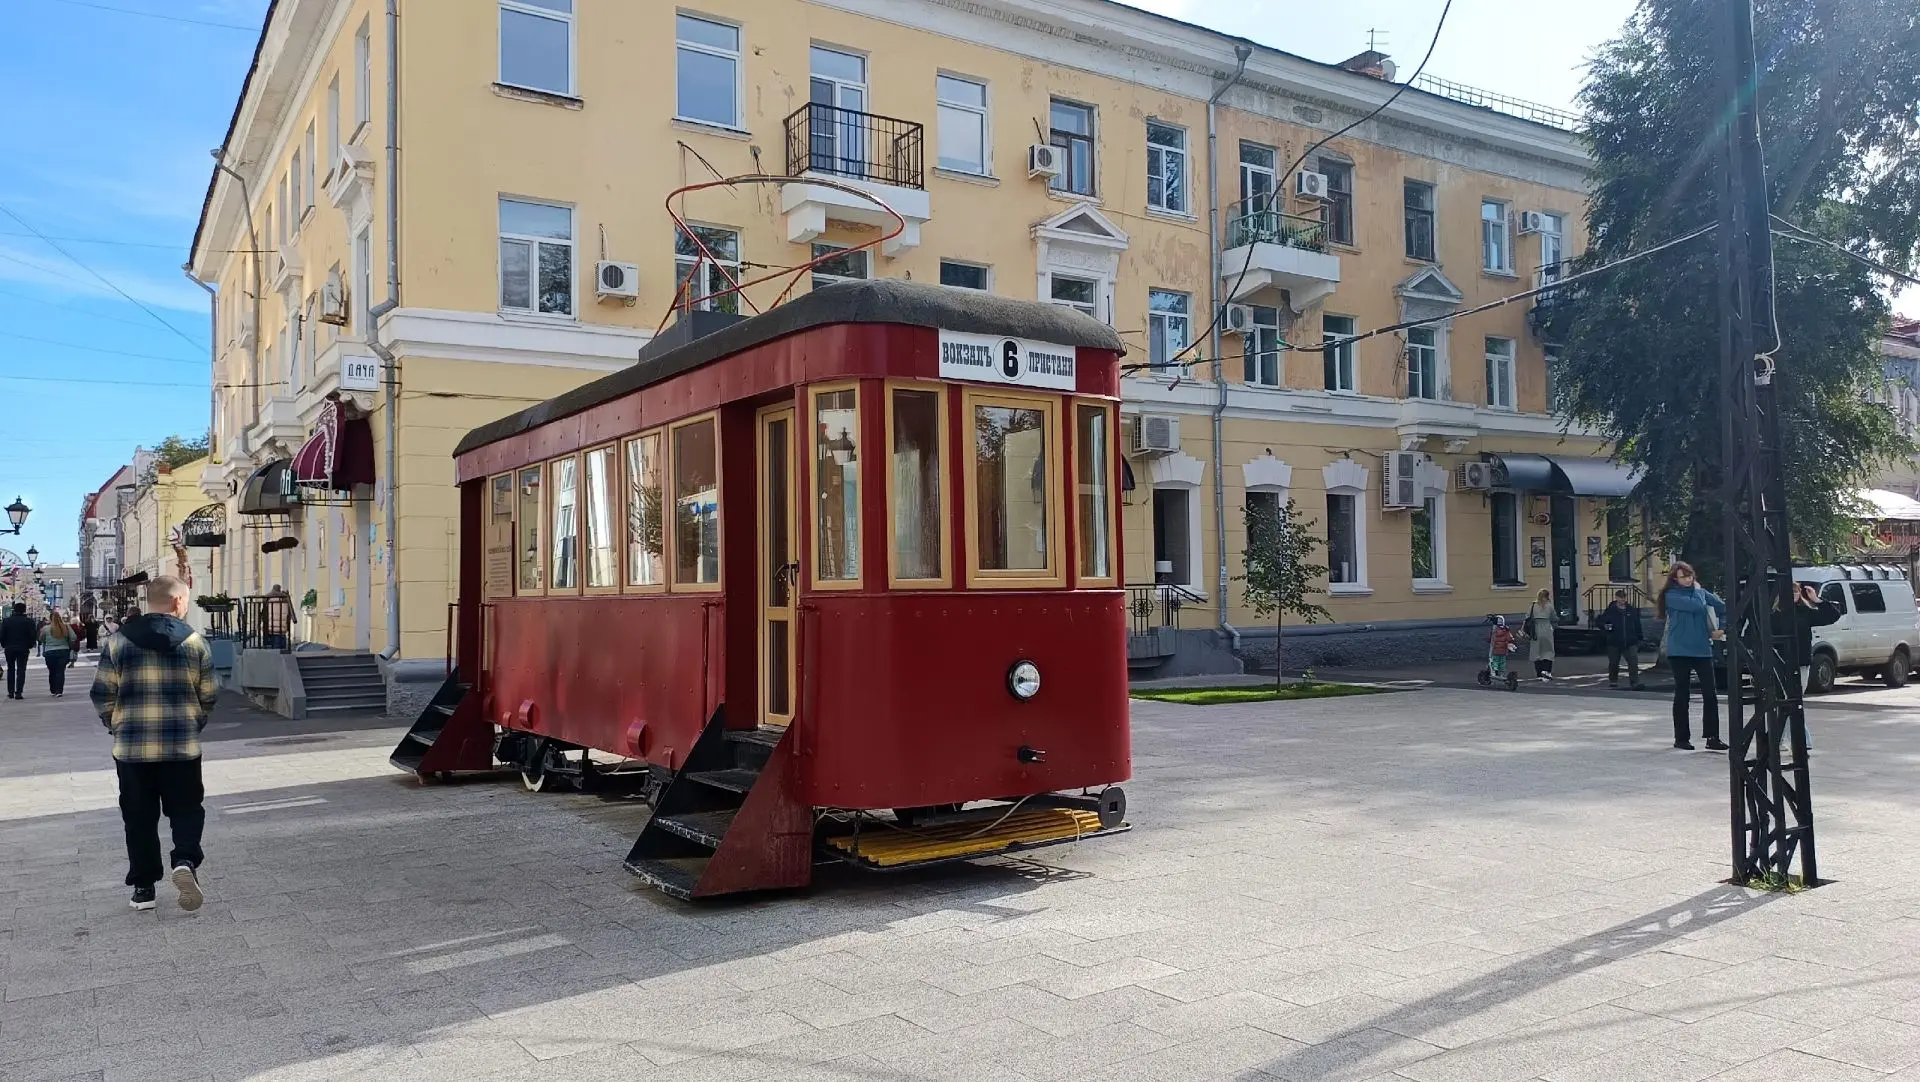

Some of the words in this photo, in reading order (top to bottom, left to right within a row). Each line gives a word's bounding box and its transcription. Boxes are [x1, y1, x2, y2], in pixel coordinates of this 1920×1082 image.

[348, 363, 374, 377] ДАЧА
[942, 342, 992, 367] ВОКЗАЛЪ
[1003, 340, 1018, 377] 6
[1029, 352, 1073, 376] ПРИСТАНИ
